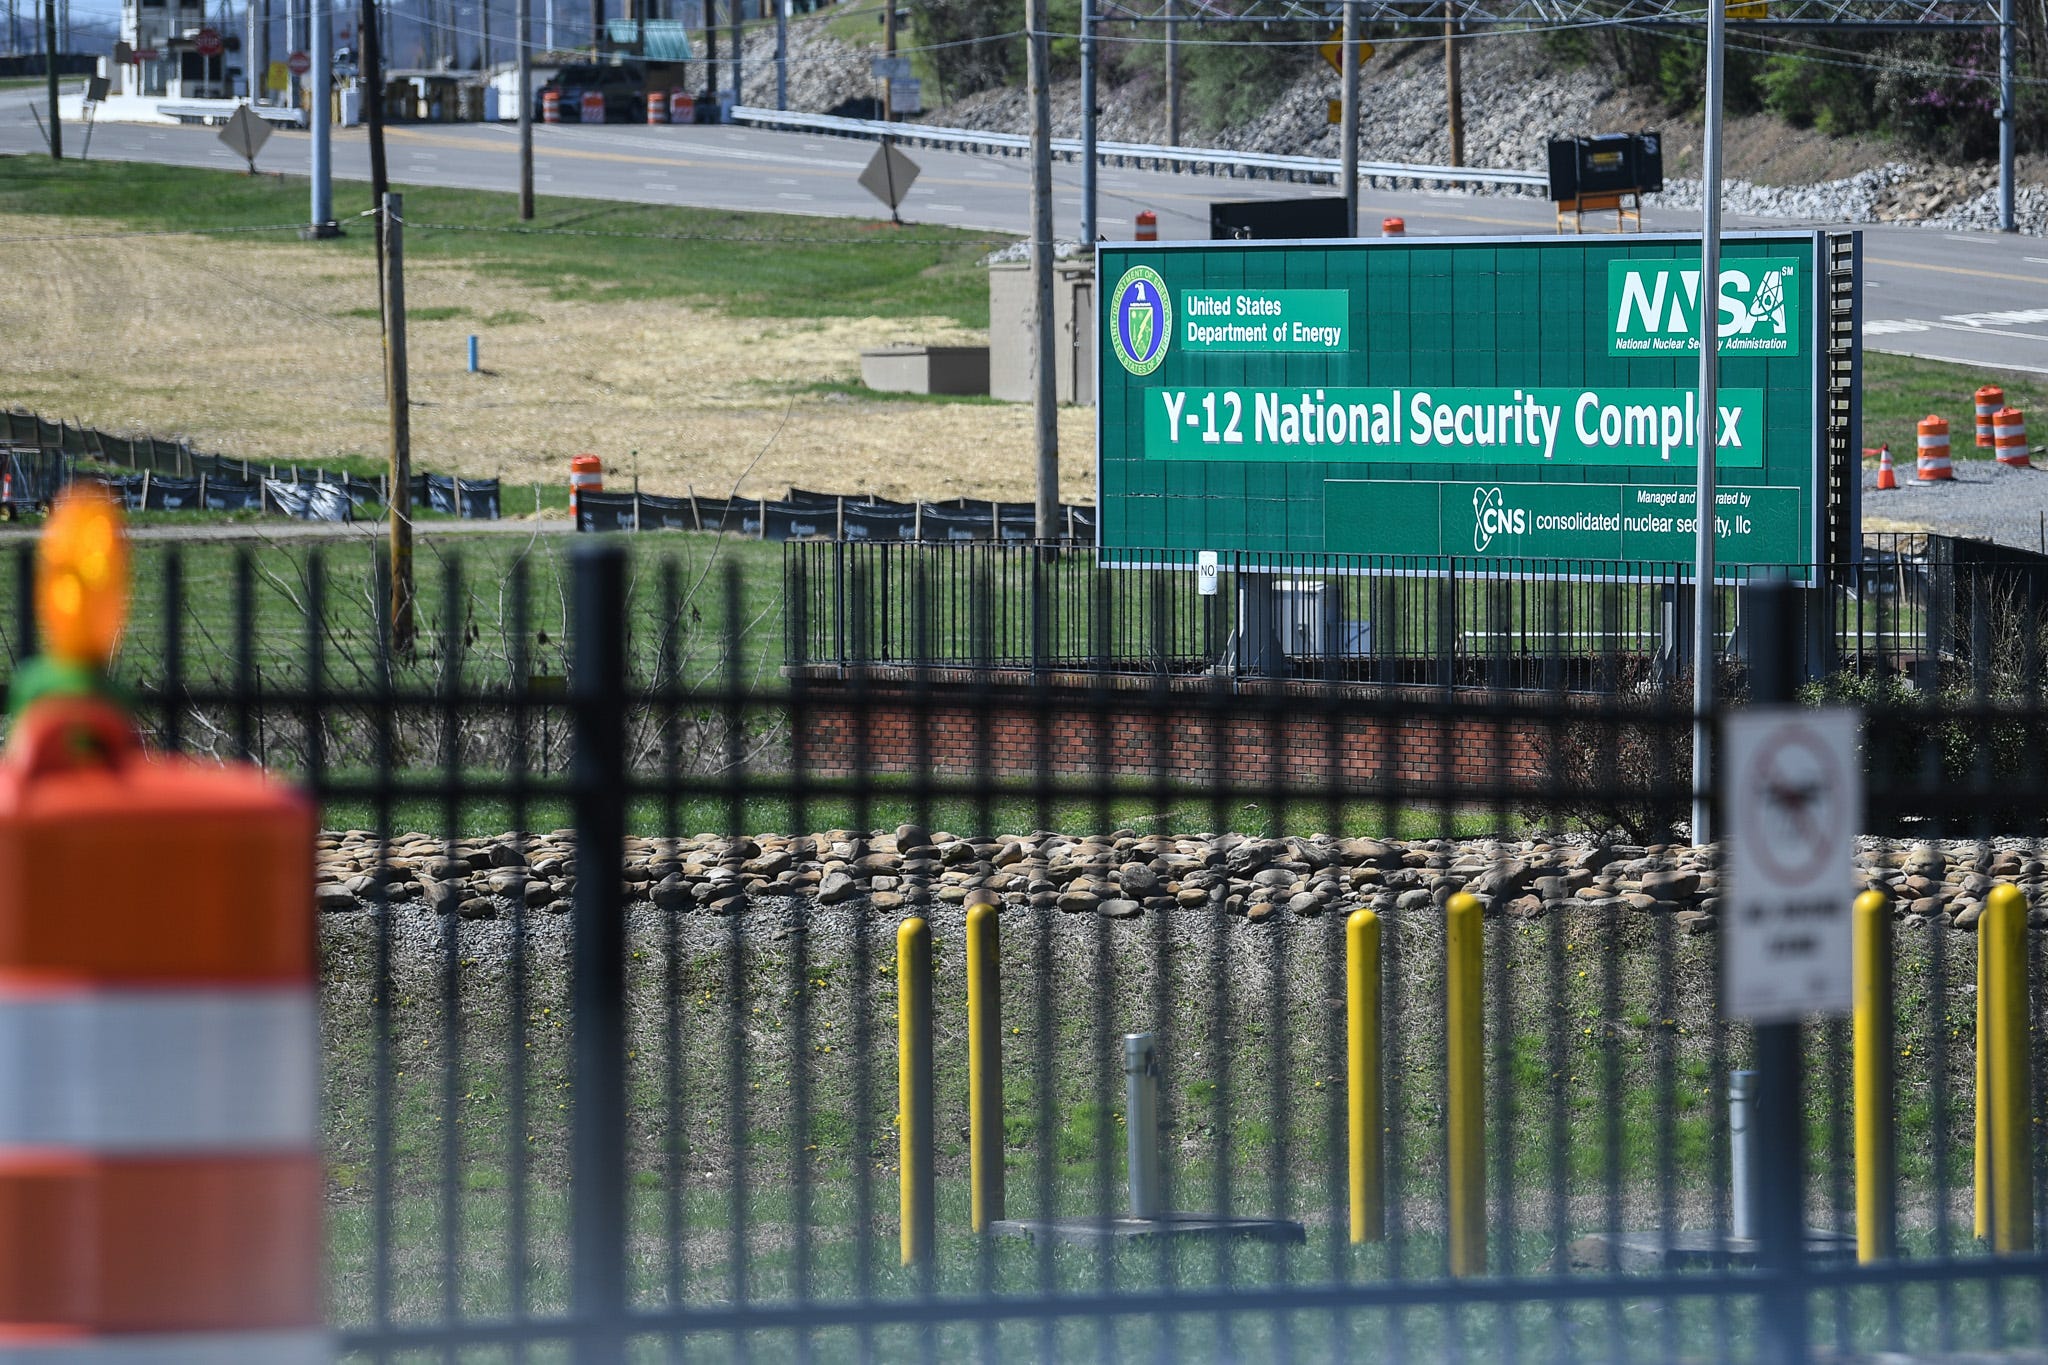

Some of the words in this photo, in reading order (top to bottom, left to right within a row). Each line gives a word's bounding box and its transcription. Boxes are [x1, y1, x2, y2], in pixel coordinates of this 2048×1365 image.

[1781, 266, 1794, 276] SM
[1112, 268, 1143, 314] DEPARTMENT
[1144, 269, 1154, 279] OF
[1153, 276, 1171, 314] ENERGY
[1187, 295, 1231, 316] United
[1236, 295, 1282, 316] States
[1187, 321, 1267, 346] Department
[1272, 321, 1288, 342] of
[1293, 321, 1342, 347] Energy
[1615, 337, 1650, 350] National
[1652, 338, 1685, 350] Nuclear
[1725, 338, 1787, 350] Administration
[1123, 356, 1147, 373] STATES
[1146, 361, 1157, 371] OF
[1162, 390, 1243, 443] Y-12
[1254, 389, 1402, 445] National
[1410, 389, 1562, 458] Security
[1574, 391, 1743, 460] Complx
[1637, 490, 1677, 507] Managed
[1678, 491, 1697, 504] and
[1739, 492, 1751, 508] by
[1483, 508, 1526, 535] CNS
[1536, 512, 1620, 531] consolidated
[1624, 514, 1673, 532] nuclear
[1676, 514, 1732, 539] secity,
[1735, 515, 1752, 534] llc
[1200, 564, 1215, 577] NO
